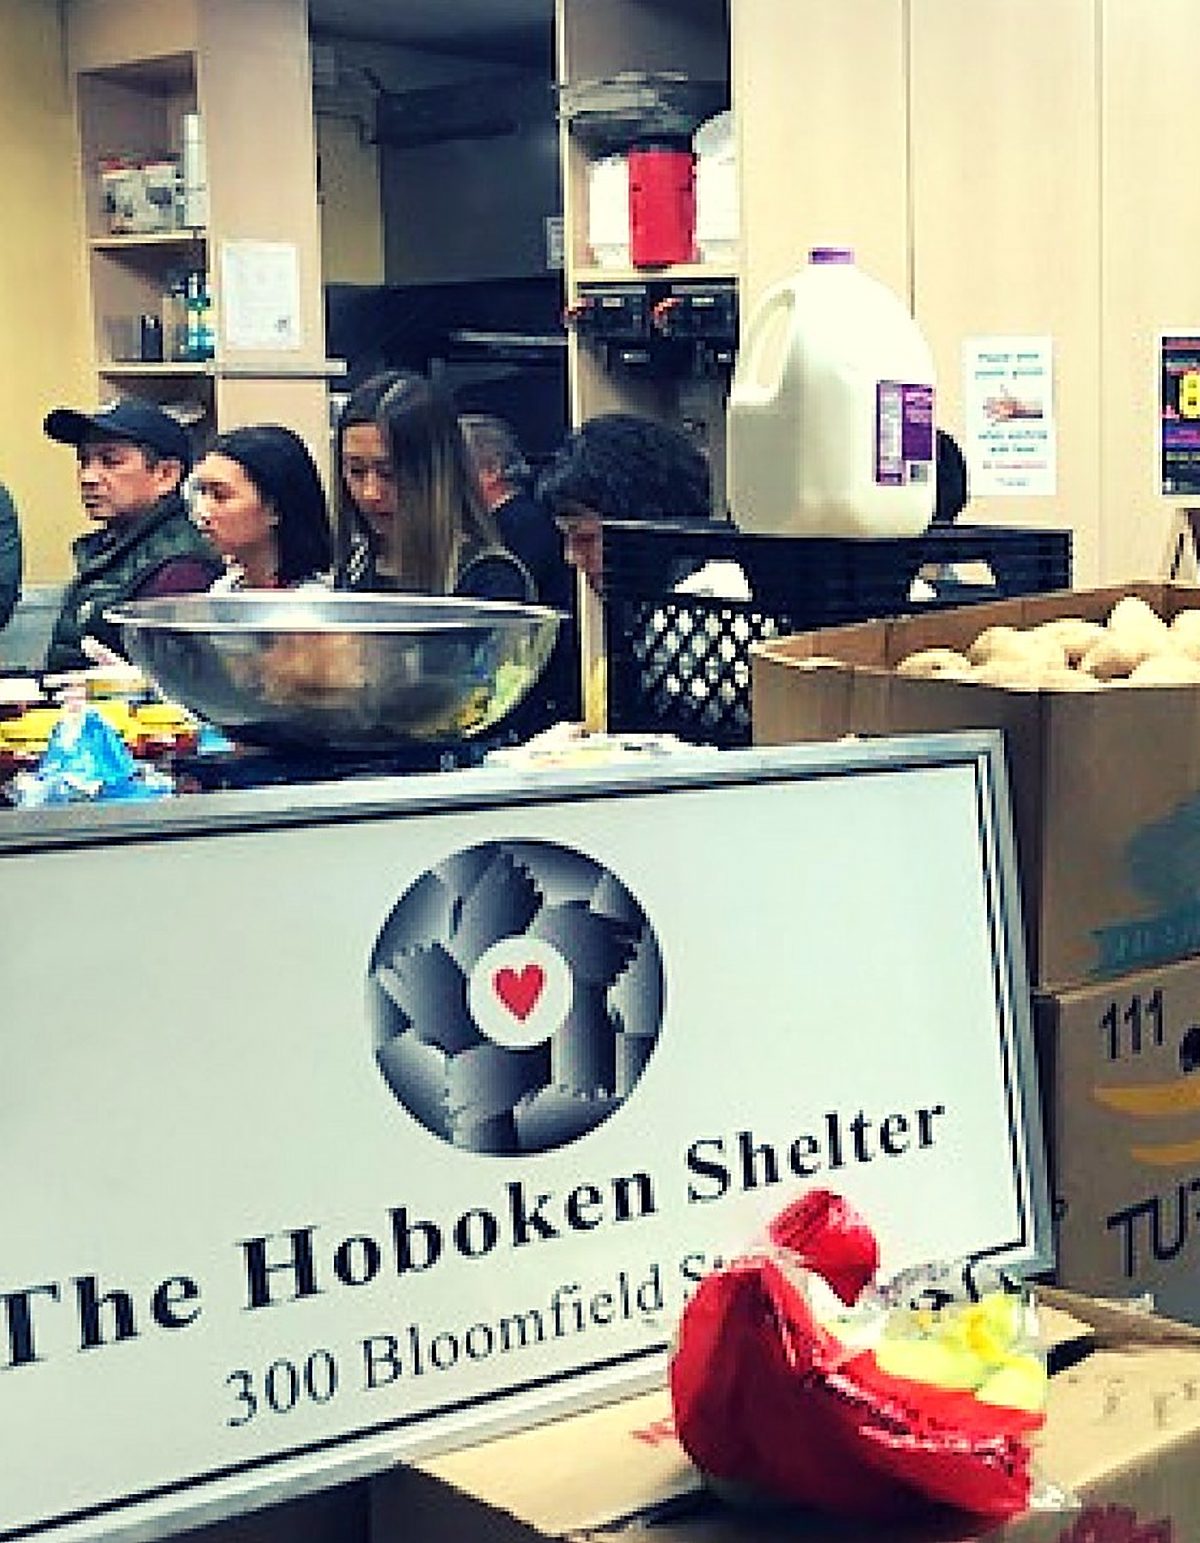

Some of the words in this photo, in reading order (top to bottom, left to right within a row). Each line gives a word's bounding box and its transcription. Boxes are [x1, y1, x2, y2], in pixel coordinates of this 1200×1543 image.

[1100, 986, 1167, 1061] 111
[0, 1272, 202, 1371] The
[232, 1171, 659, 1311] Hoboken
[685, 1102, 945, 1204] Shelter
[225, 1348, 339, 1428] 300
[358, 1262, 664, 1391] Bloomfield
